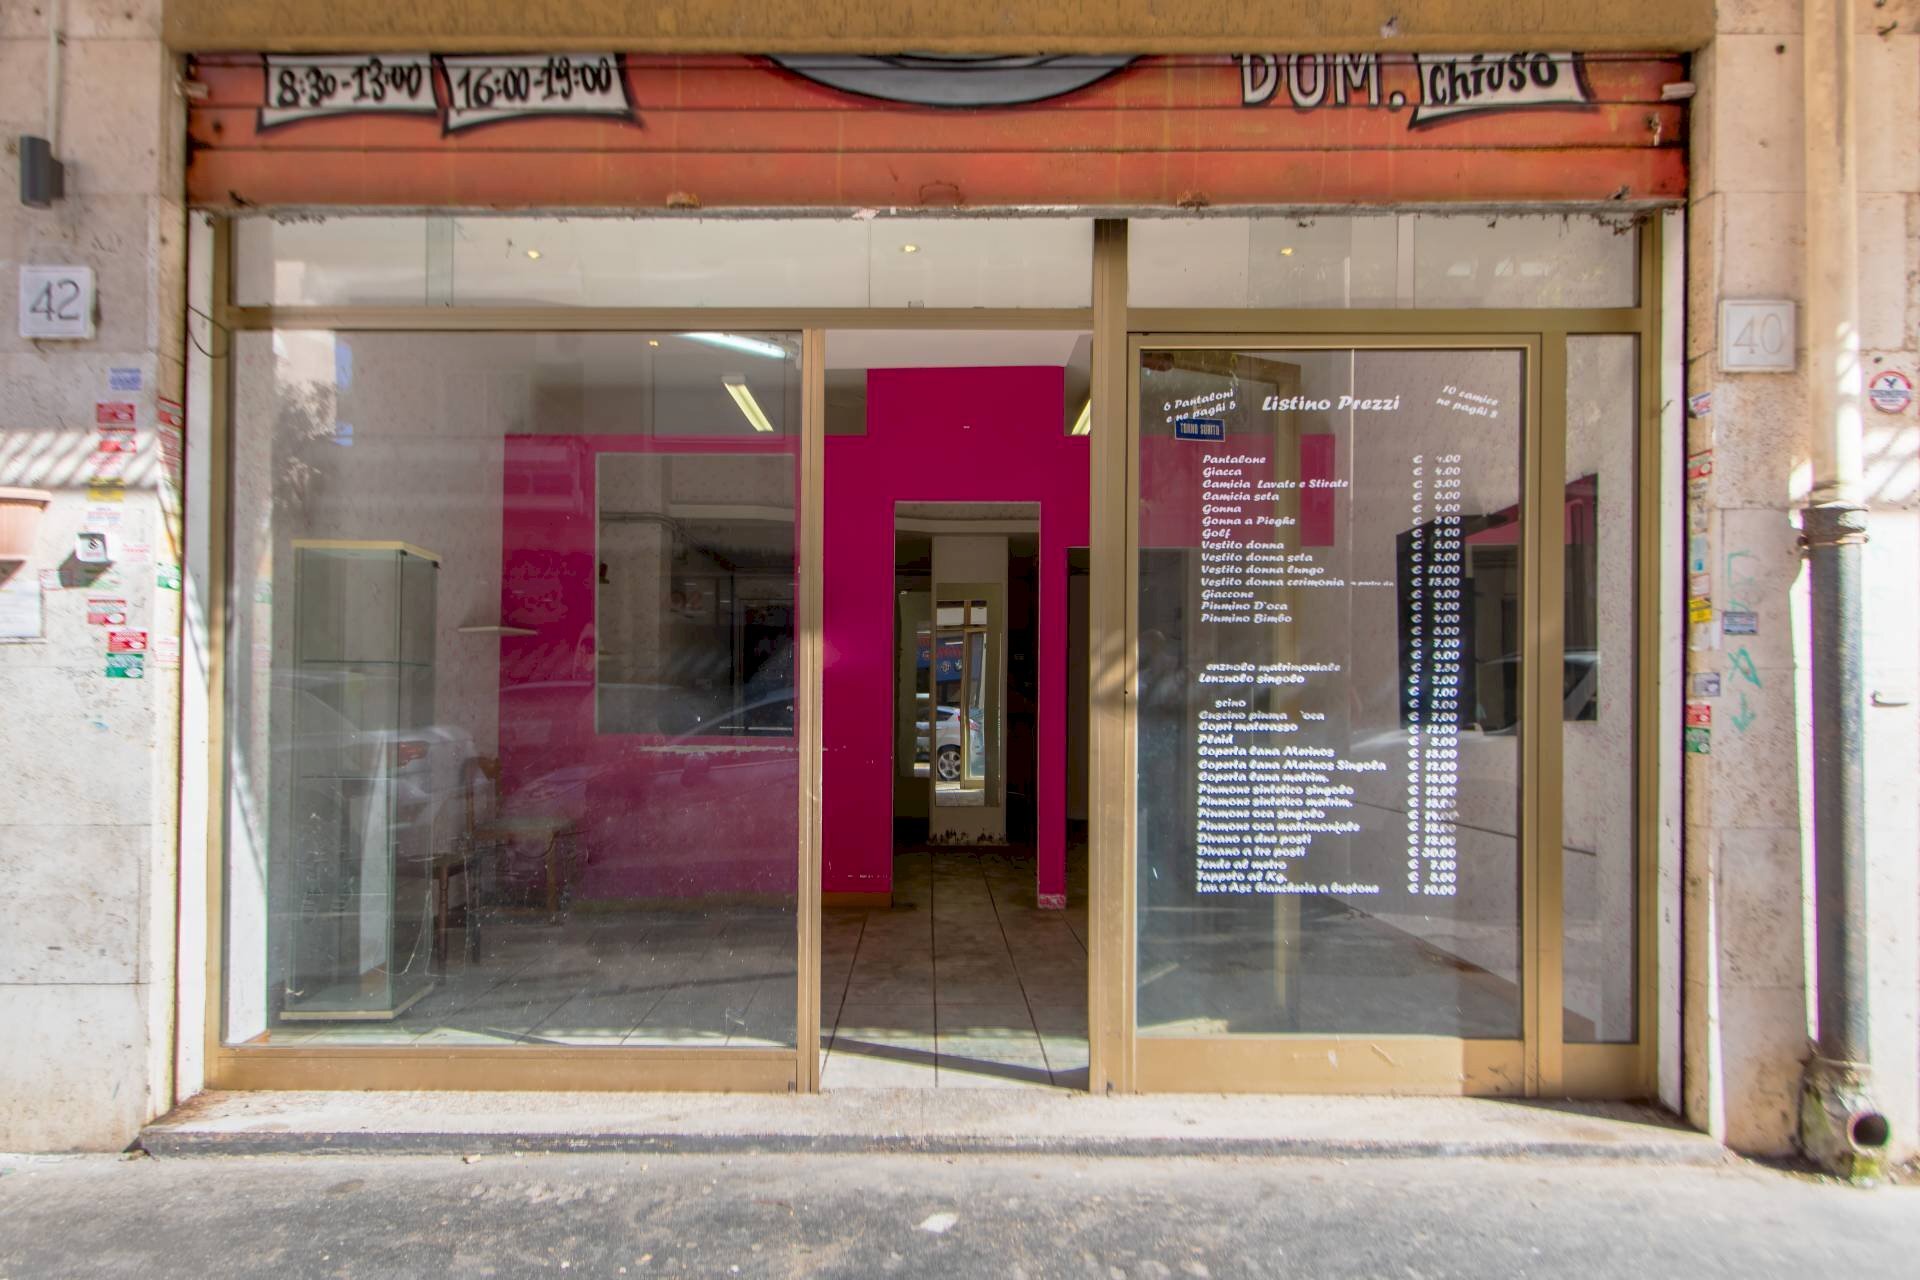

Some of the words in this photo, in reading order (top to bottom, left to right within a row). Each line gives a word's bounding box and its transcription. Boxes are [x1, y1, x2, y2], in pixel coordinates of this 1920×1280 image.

[1234, 52, 1408, 108] DOM.
[29, 278, 81, 320] 42
[1733, 312, 1784, 355] 40
[1174, 388, 1234, 409] Pantaloni
[1442, 385, 1456, 394] 10
[1459, 390, 1499, 406] camice
[1262, 396, 1331, 411] Listino
[1338, 395, 1400, 410] Prezzi
[1436, 397, 1450, 406] ne
[1453, 402, 1488, 416] paghi
[1166, 415, 1172, 423] e
[1176, 411, 1189, 422] ne
[1193, 403, 1226, 419] paghi
[1203, 454, 1266, 464] Pantalone
[1203, 467, 1242, 477] Giacca
[1202, 480, 1250, 489] Camicia
[1257, 480, 1295, 489] Lavate
[1308, 480, 1348, 489] Stirate
[1202, 492, 1250, 501] Camicia
[1253, 492, 1279, 501] seta
[1202, 504, 1241, 514] Gonna
[1202, 516, 1241, 526] Gonna
[1257, 516, 1295, 526] Pieghe
[1202, 528, 1231, 539] Golf
[1202, 540, 1242, 550] Vestito
[1246, 540, 1284, 550] donna
[1202, 553, 1242, 562] Vestito
[1246, 553, 1284, 562] donna
[1287, 553, 1313, 562] seta
[1201, 565, 1242, 575] Vestito
[1246, 565, 1284, 575] donna
[1287, 565, 1324, 575] lungo
[1201, 578, 1242, 587] Vestito
[1246, 578, 1284, 587] donna
[1287, 578, 1345, 587] cerimonia
[1201, 590, 1254, 600] Giaccone
[1201, 602, 1251, 612] Piumino
[1201, 614, 1250, 624] Piumino
[1254, 614, 1292, 624] Bimbo
[1259, 662, 1340, 672] matrimoniale
[1199, 673, 1254, 684] Lenzuolo
[1256, 673, 1304, 684] singolo
[1198, 710, 1246, 721] Cuscino
[1249, 710, 1288, 721] piuma
[1198, 722, 1232, 732] Copri
[1234, 722, 1298, 732] materasso
[1198, 734, 1234, 744] Plaid
[1198, 746, 1247, 757] Coperta
[1198, 760, 1247, 772] Coperta
[1198, 772, 1247, 782] Coperta
